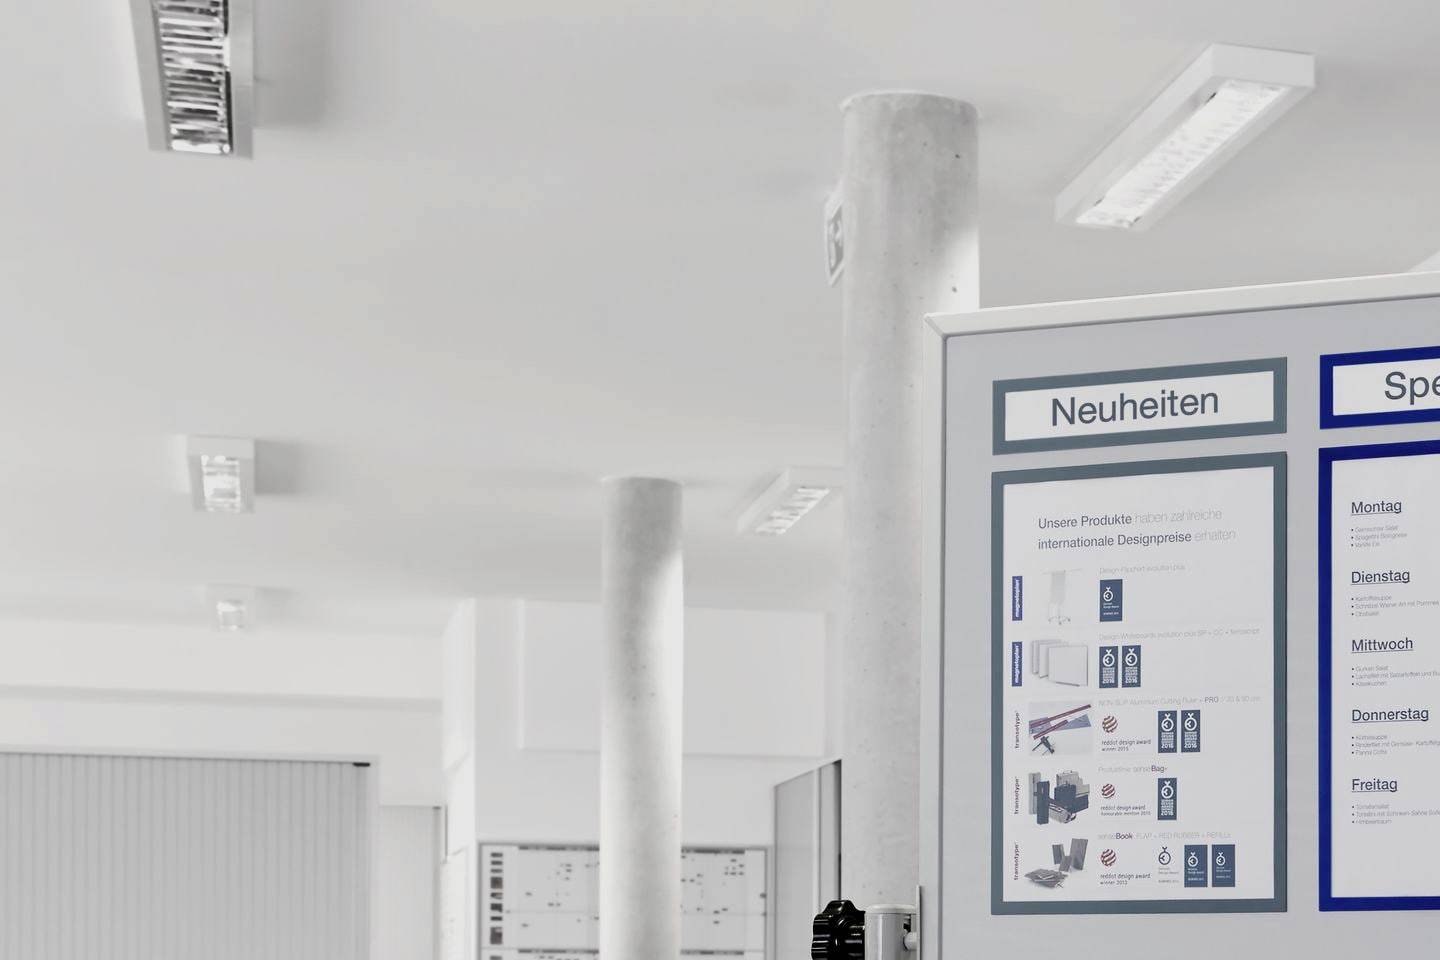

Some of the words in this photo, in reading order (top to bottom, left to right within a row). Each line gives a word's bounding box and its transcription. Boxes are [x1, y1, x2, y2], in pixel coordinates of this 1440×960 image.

[1052, 389, 1218, 426] Neuheiten
[1351, 500, 1401, 515] Montag
[1038, 518, 1077, 529] Unsere
[1081, 513, 1132, 527] Produkte
[1038, 535, 1114, 549] internationale
[1117, 530, 1192, 546] Designpreise
[1351, 570, 1410, 585] Dienstag
[1351, 637, 1413, 652] Mittwoch
[1351, 708, 1428, 723] Donnerstag
[1351, 778, 1397, 792] Freitag
